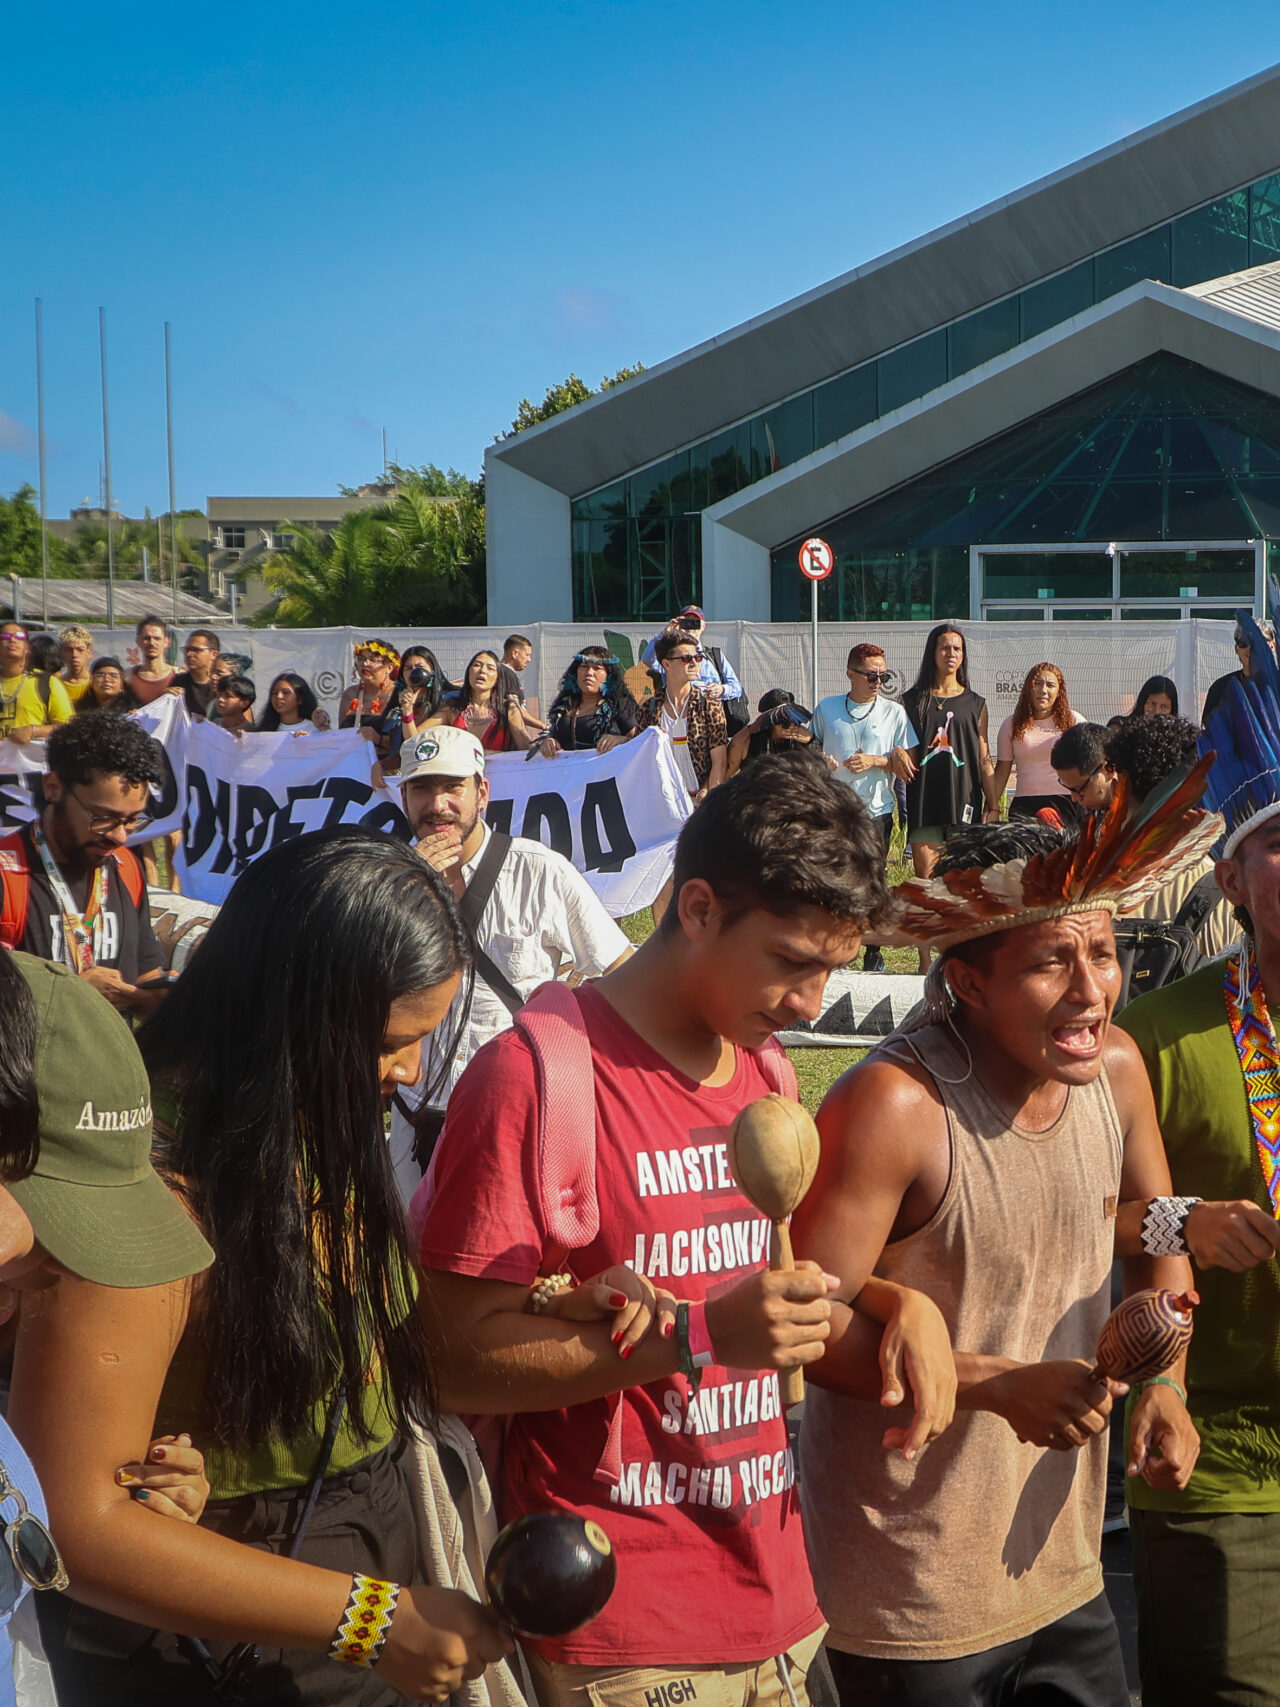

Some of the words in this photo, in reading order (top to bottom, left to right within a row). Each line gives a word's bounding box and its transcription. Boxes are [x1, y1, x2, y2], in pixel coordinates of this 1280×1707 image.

[810, 547, 821, 570] E
[996, 671, 1028, 682] COP3
[996, 683, 1024, 693] BRAS
[636, 1144, 737, 1197] AMSTE
[661, 1373, 781, 1436] SANTIAGO
[610, 1462, 733, 1509] MACHU
[643, 1678, 697, 1707] HIGH
